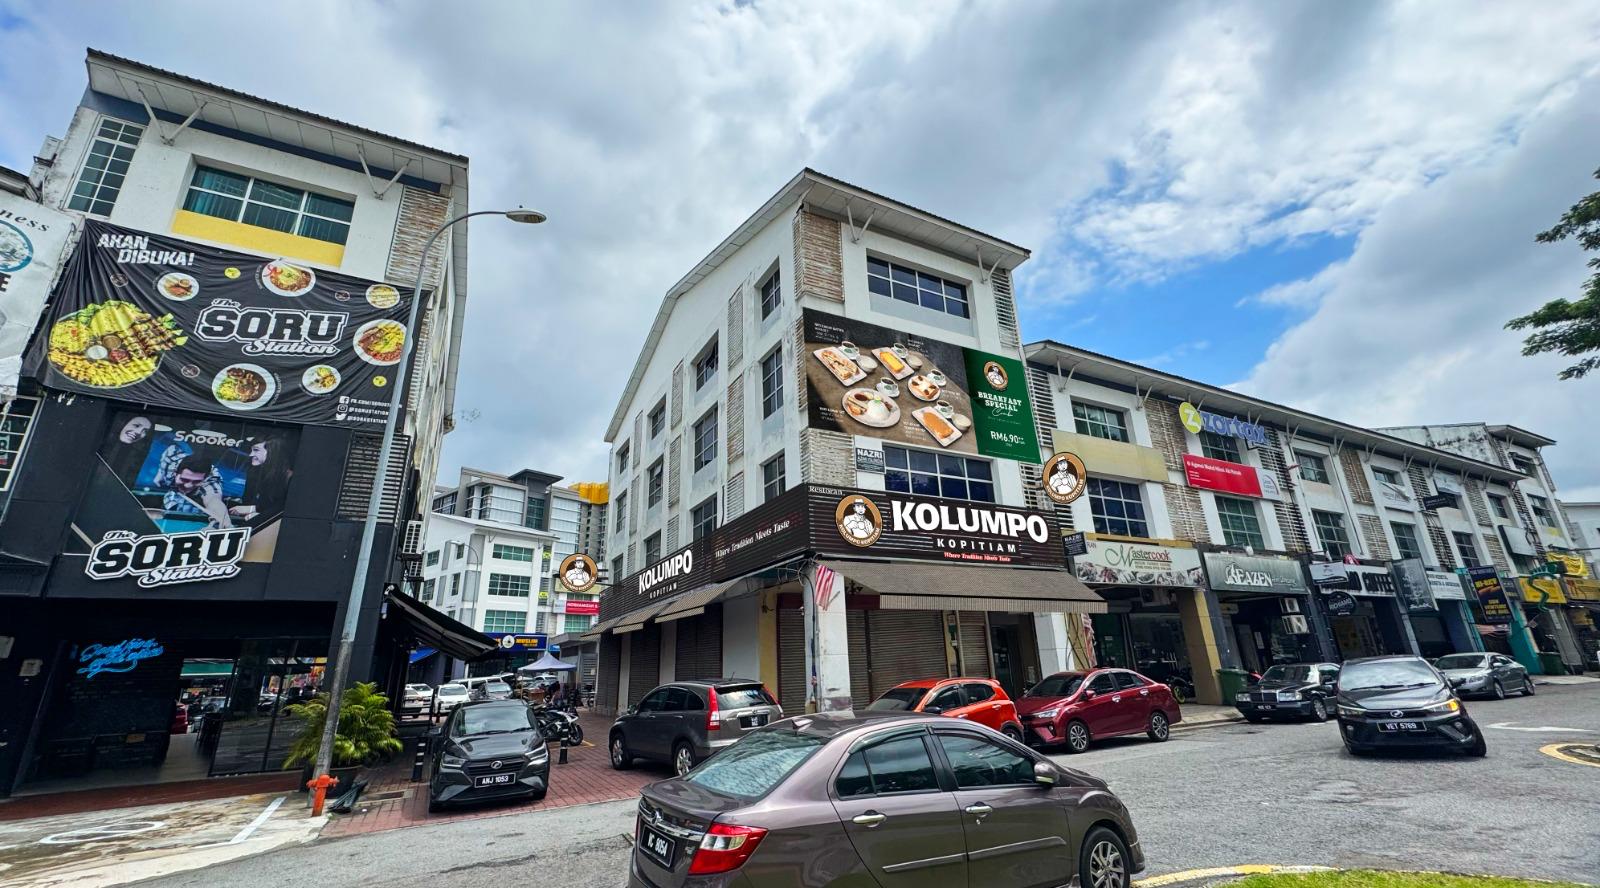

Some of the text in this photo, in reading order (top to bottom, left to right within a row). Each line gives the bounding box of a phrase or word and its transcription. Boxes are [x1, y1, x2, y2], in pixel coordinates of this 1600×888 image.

[97, 233, 149, 249] AKAN
[117, 248, 195, 266] DIBUKA!
[196, 306, 348, 345] SORU
[244, 339, 339, 355] Station
[977, 391, 1022, 406] BREAKFAST
[984, 399, 1018, 412] SPECIAL
[174, 430, 245, 447] Snooker
[856, 448, 883, 459] NAZRI
[773, 519, 790, 533] Taste
[891, 500, 1049, 543] KOLUMPO
[104, 529, 138, 541] The
[87, 528, 249, 578] SORU
[937, 538, 1017, 553] KOPITIAM
[1104, 544, 1170, 567] Mastercook
[141, 564, 239, 584] Station
[638, 549, 693, 595] KOLUMPO
[481, 775, 509, 785] ANJ 1053
